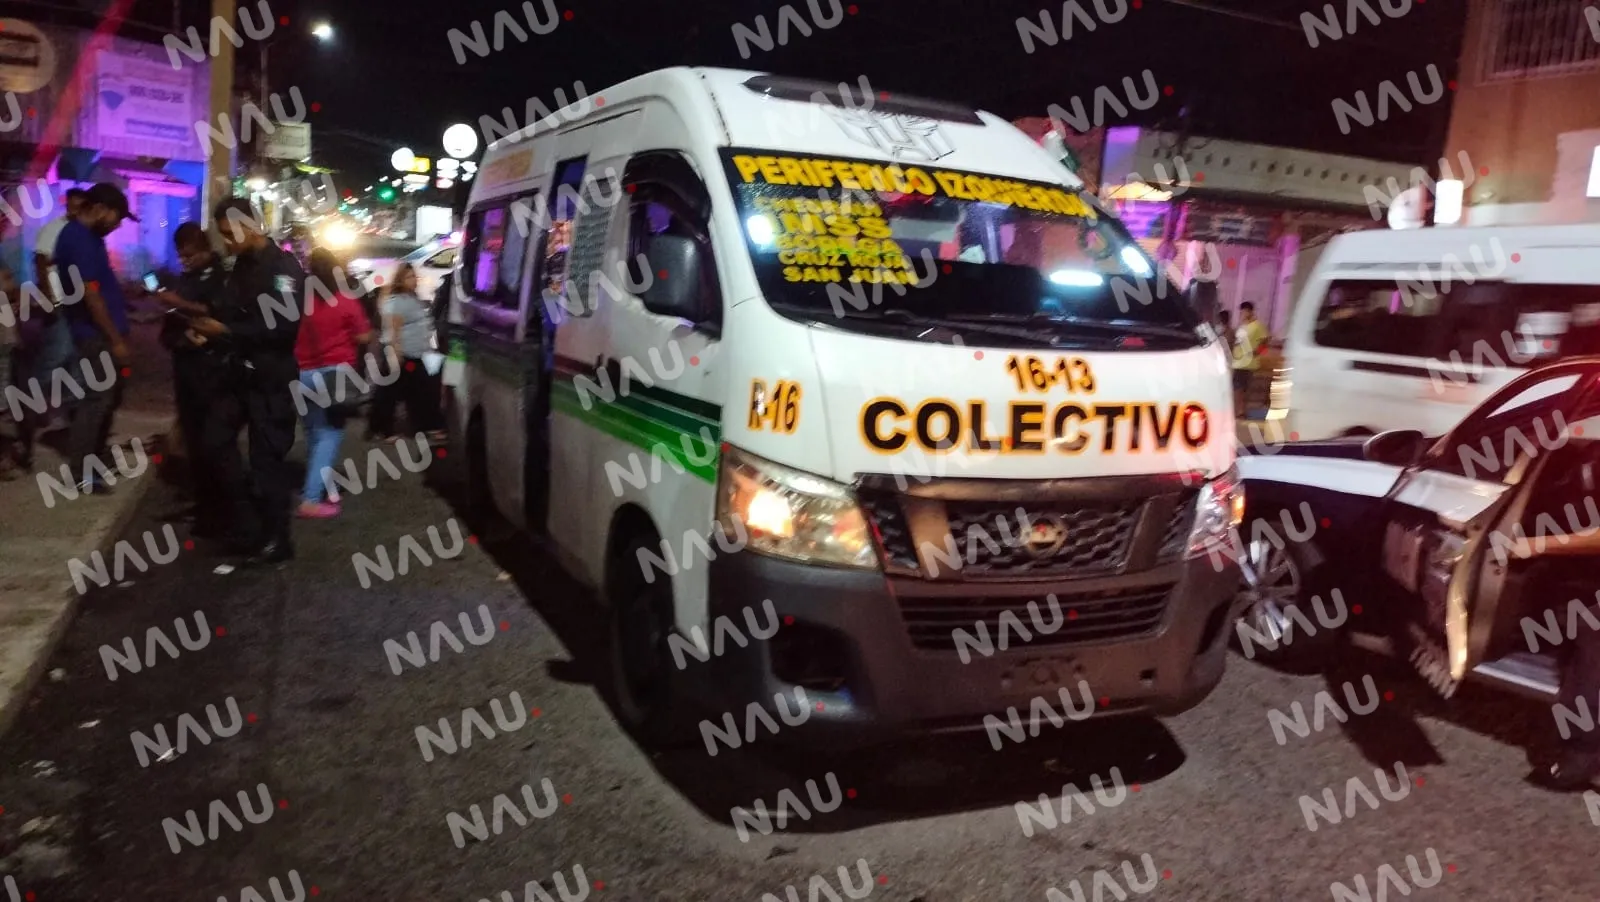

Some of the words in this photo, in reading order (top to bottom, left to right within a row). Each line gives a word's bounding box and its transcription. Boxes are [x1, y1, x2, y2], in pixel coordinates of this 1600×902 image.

[732, 155, 937, 196] PERIFERICO
[782, 266, 842, 284] SAN
[848, 267, 920, 286] JUAN
[1006, 355, 1096, 395] 16-13
[860, 398, 1210, 455] COLECTIVO
